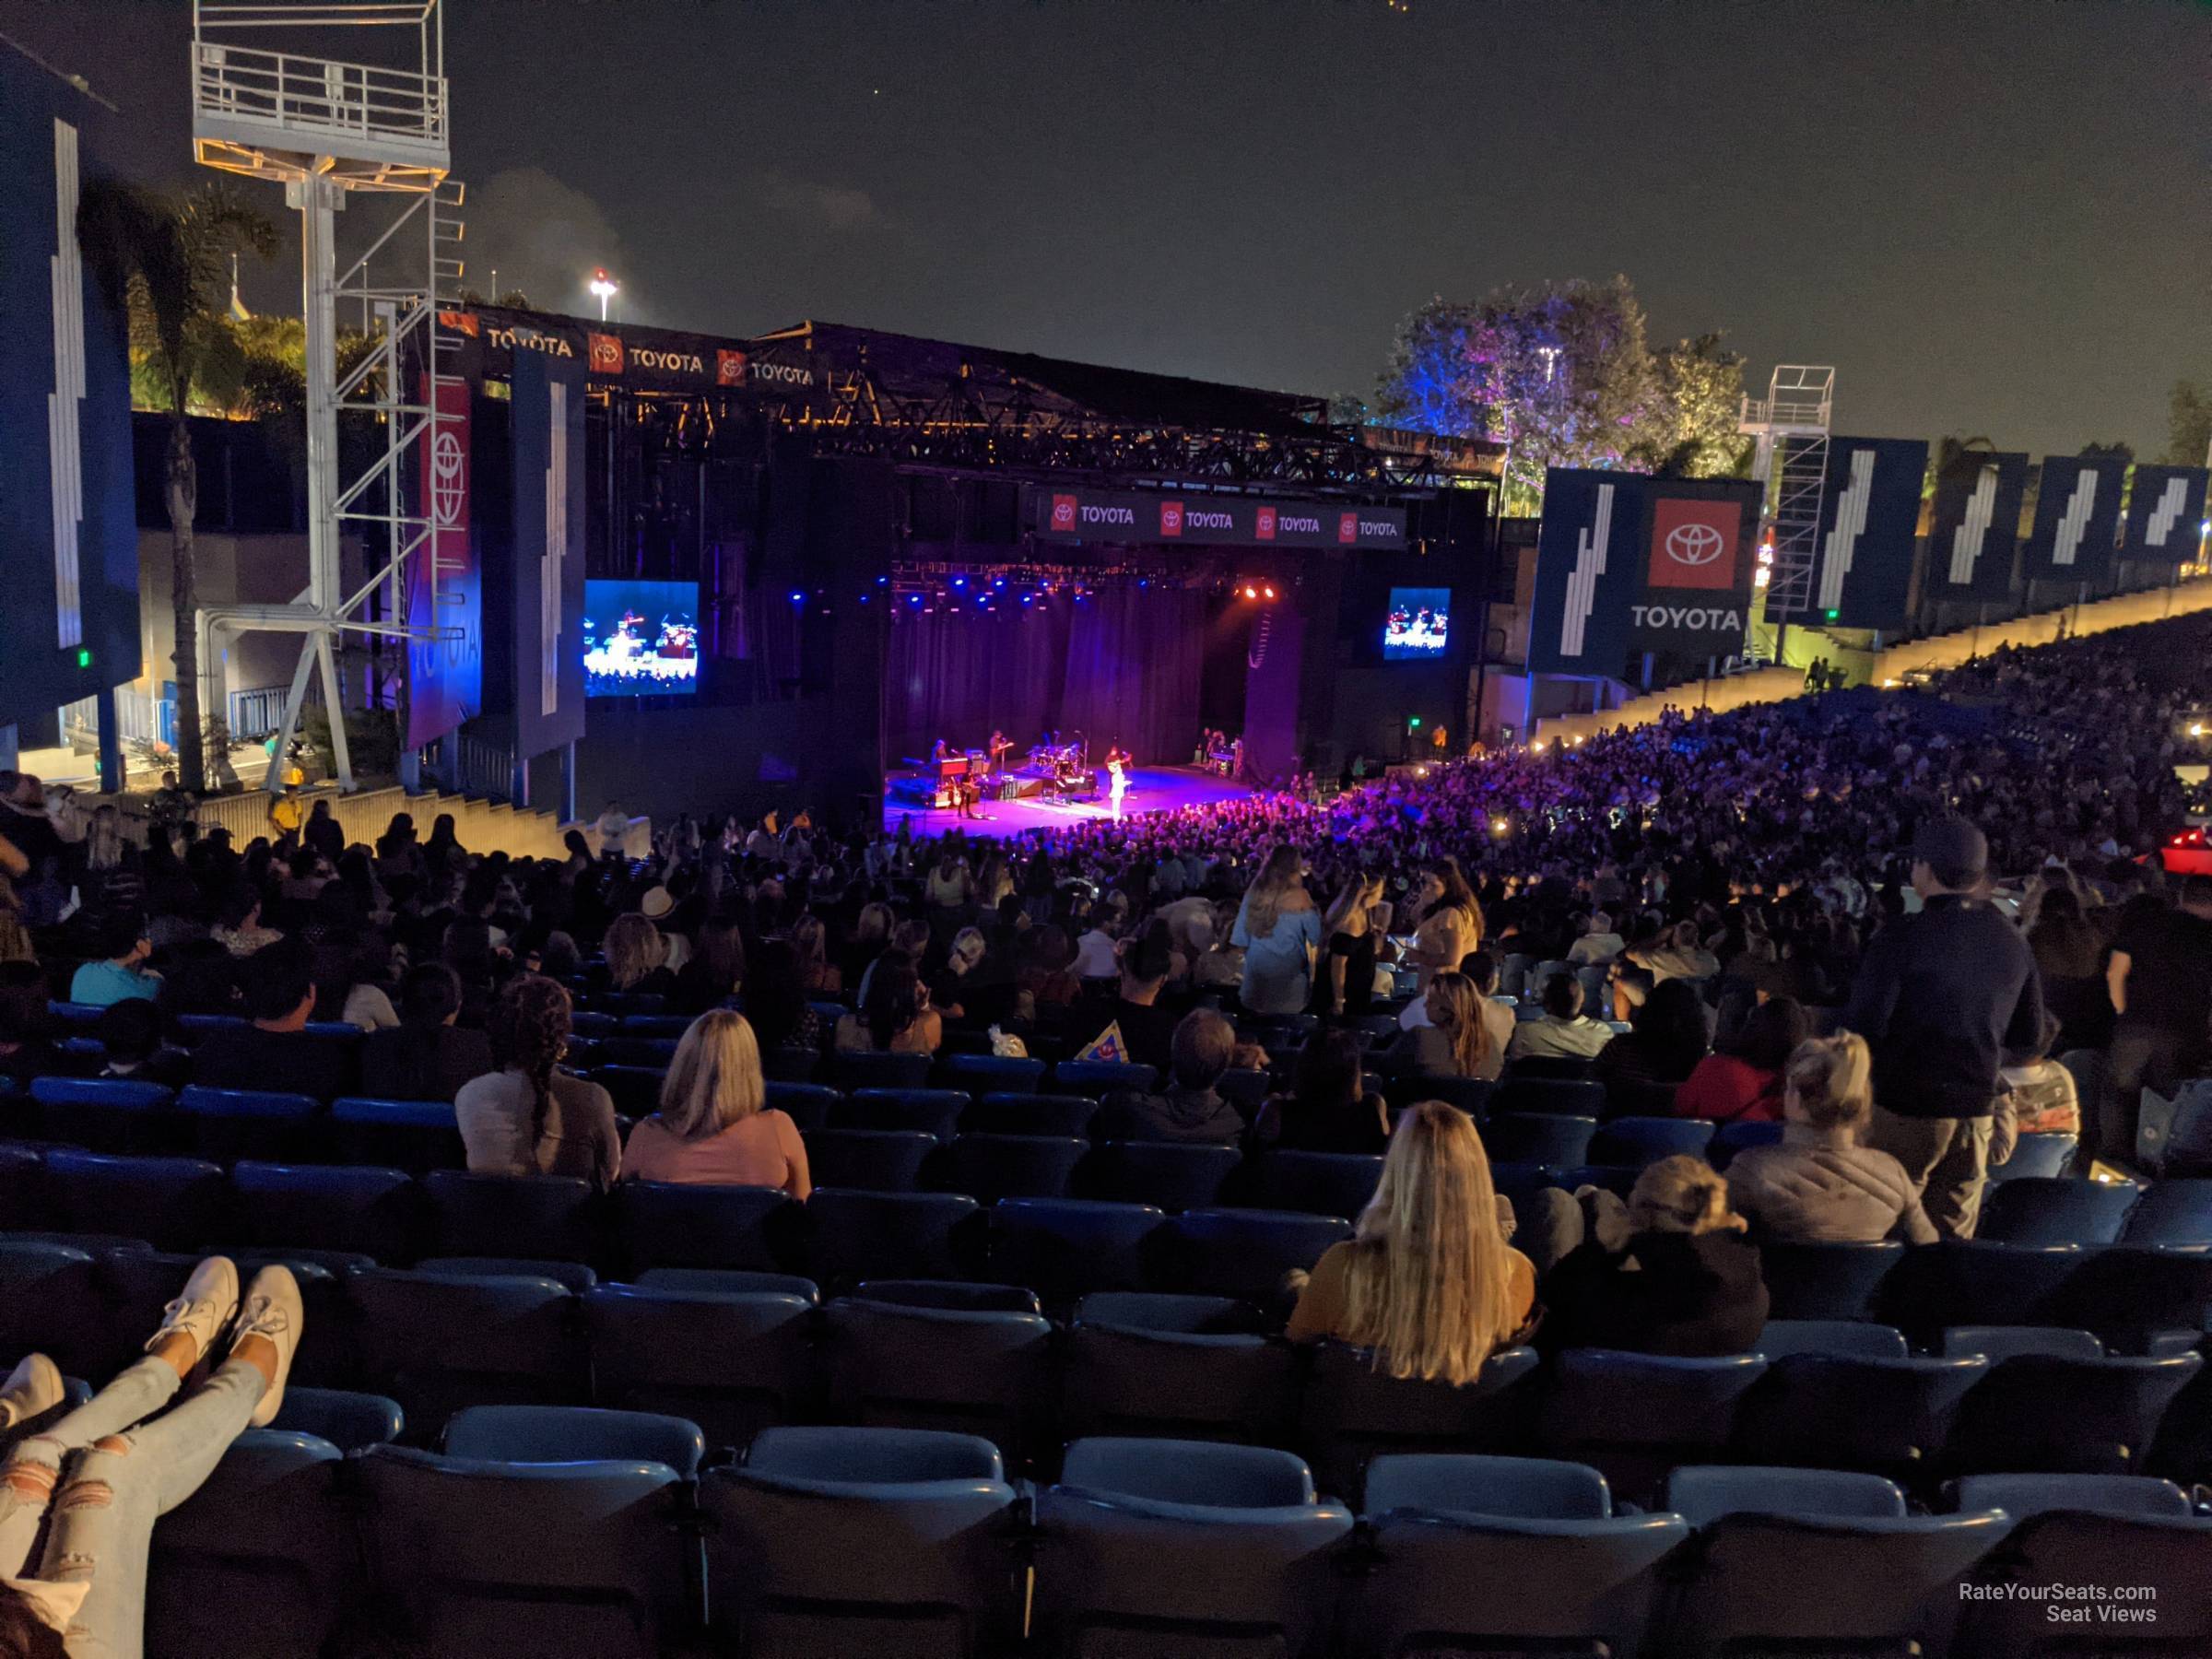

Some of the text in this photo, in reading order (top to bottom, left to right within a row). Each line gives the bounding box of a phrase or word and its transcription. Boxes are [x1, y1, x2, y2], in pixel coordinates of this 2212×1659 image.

[629, 348, 703, 373] TOYOTA
[751, 362, 814, 385] TOYOTA
[1080, 506, 1134, 524] TOYOTA
[1186, 512, 1233, 529] TOYOTA
[1278, 516, 1320, 533] TOYOTA
[1359, 521, 1397, 536] TOYOTA
[1630, 605, 1742, 631] TOYOTA
